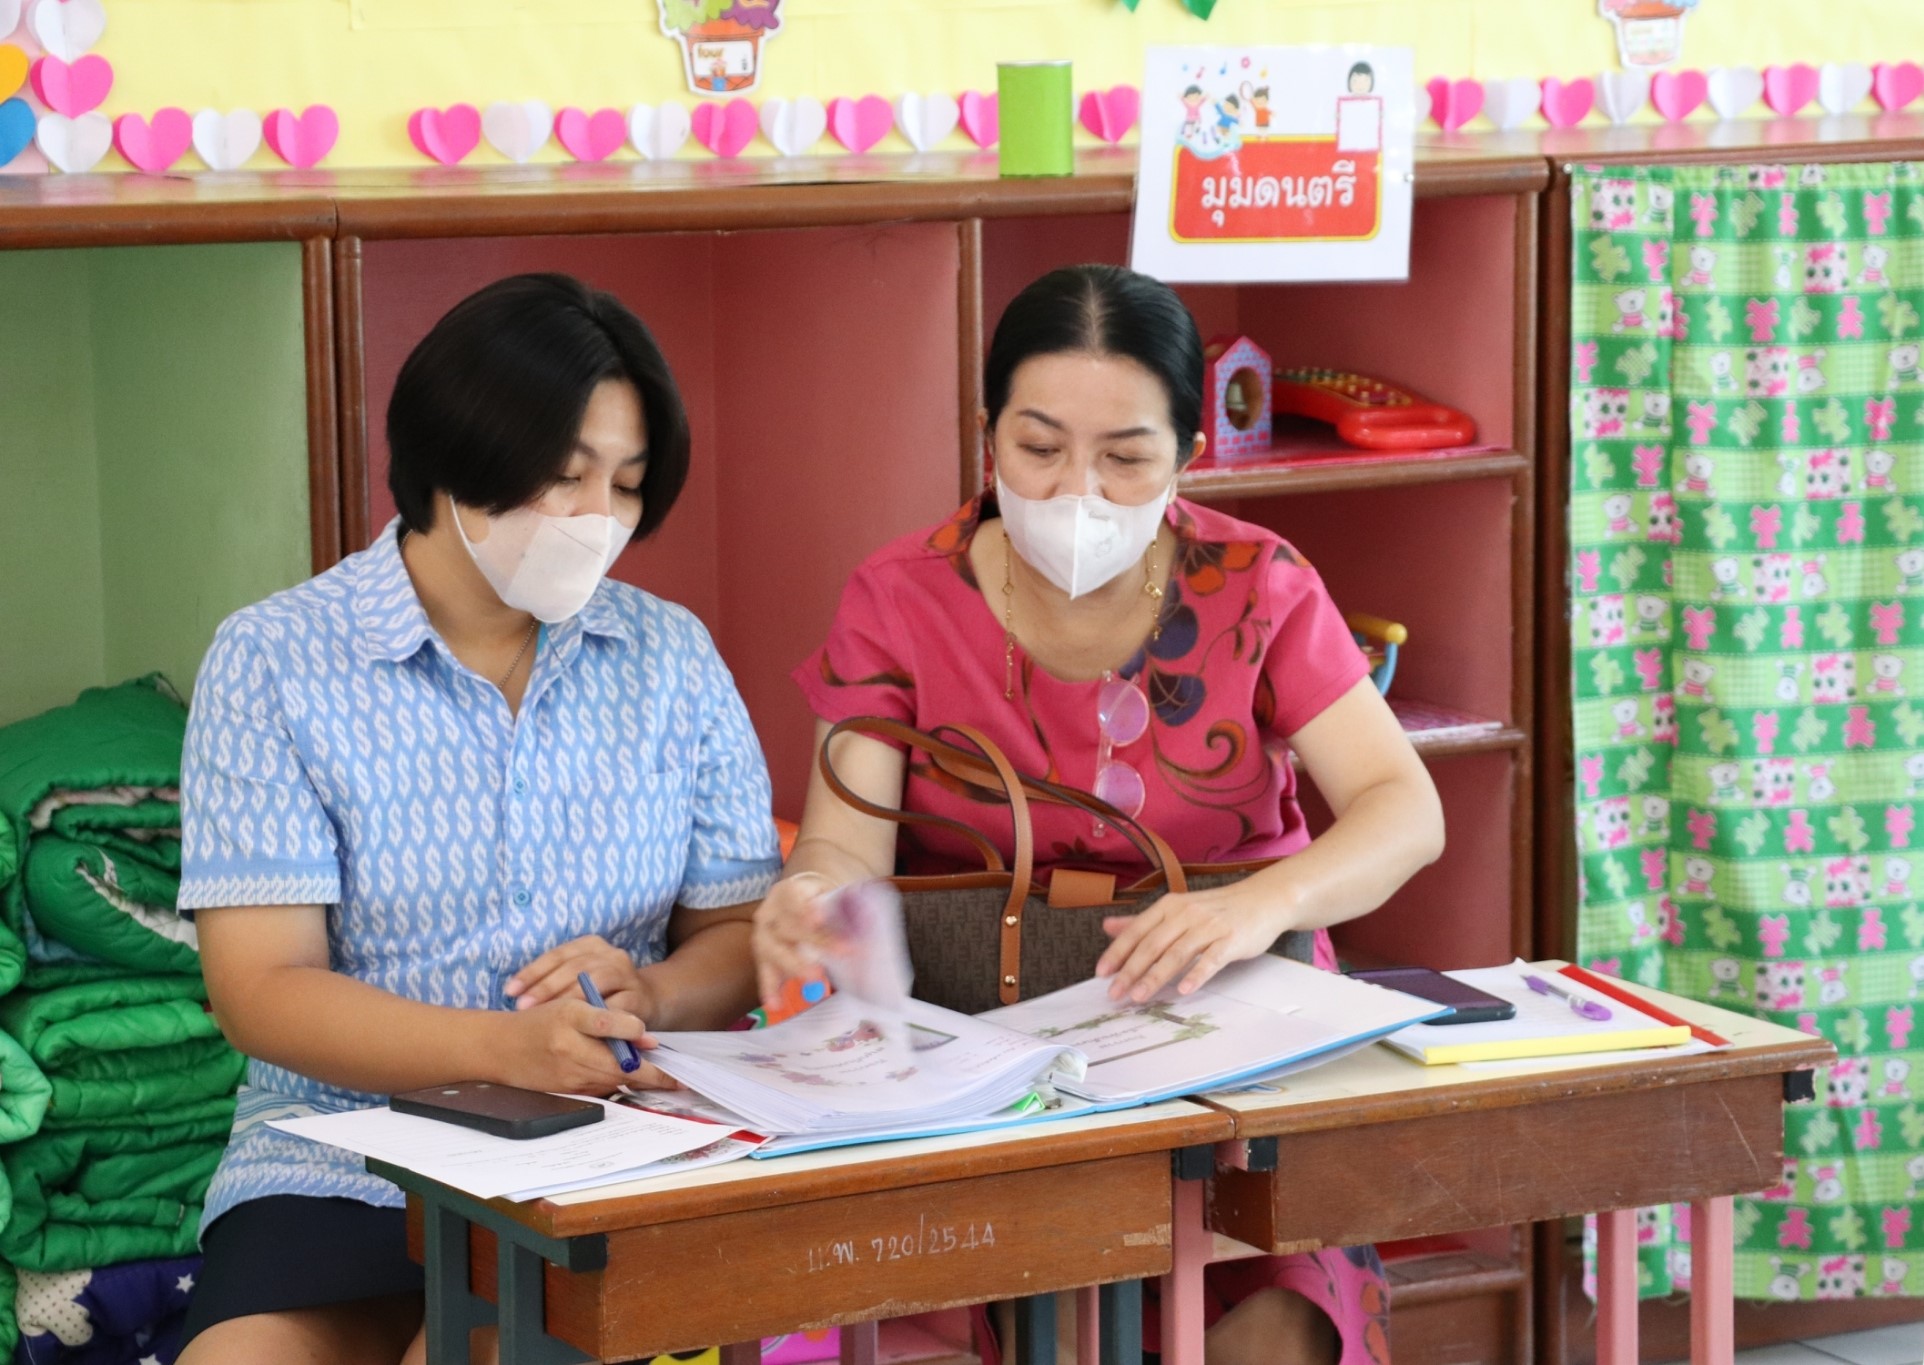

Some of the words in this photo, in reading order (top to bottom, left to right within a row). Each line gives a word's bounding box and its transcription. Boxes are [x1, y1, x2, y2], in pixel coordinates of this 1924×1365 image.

[1201, 159, 1356, 228] มุมดนตรี
[871, 1212, 996, 1262] 720/2544
